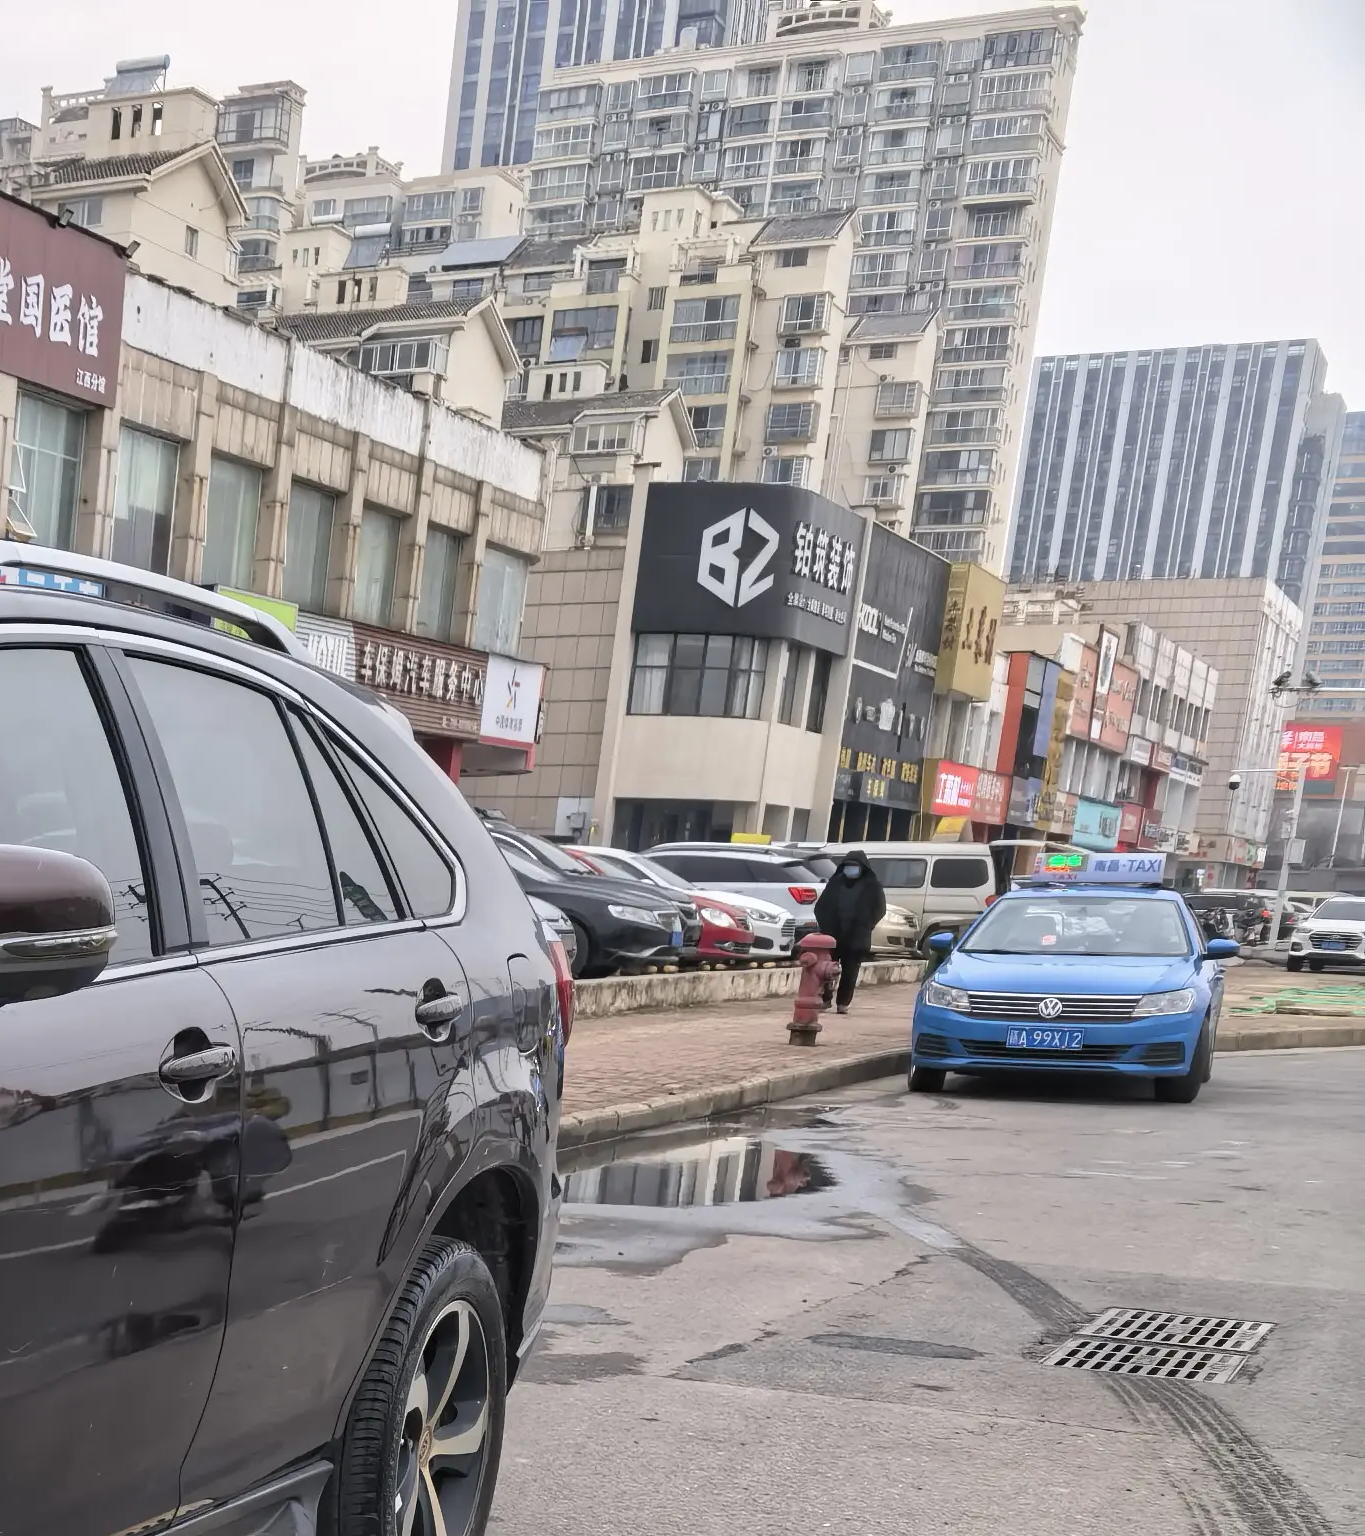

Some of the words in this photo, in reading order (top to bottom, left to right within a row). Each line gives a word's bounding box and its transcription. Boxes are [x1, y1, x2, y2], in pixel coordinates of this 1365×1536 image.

[76, 366, 107, 395] 江西分馆
[794, 520, 856, 597] 铂筑装饰
